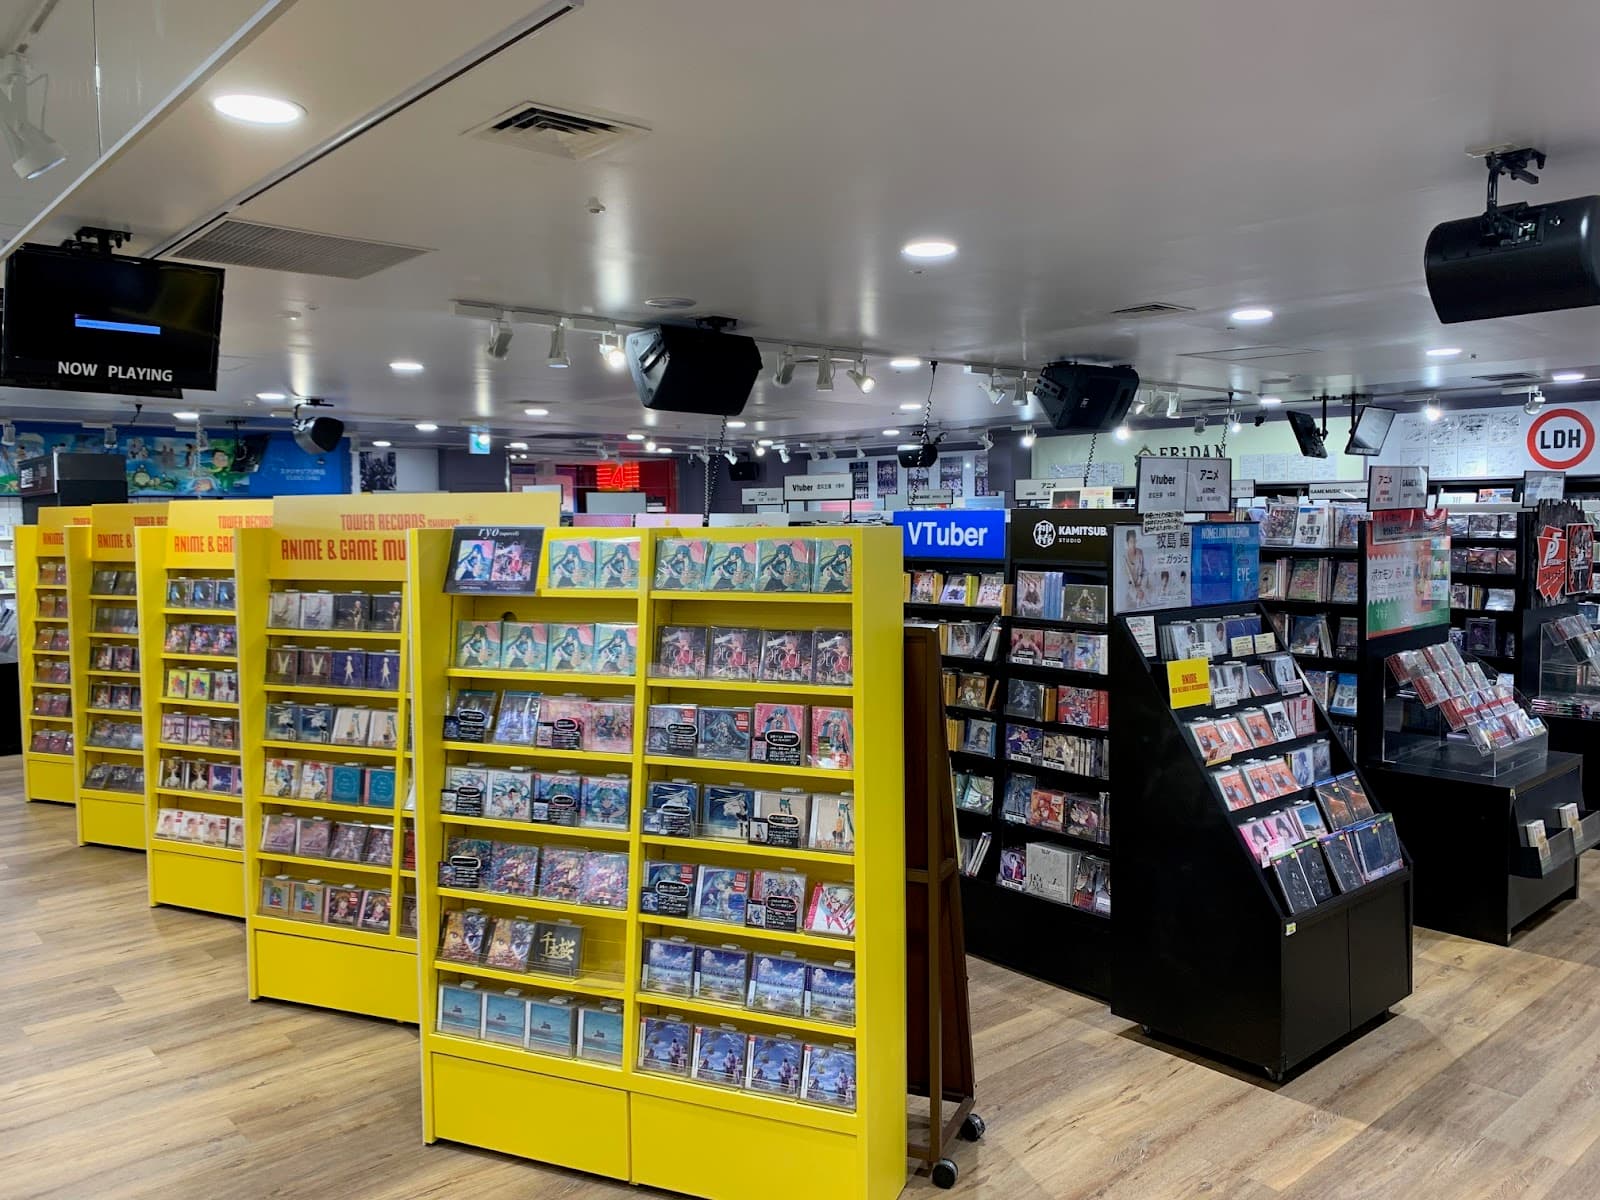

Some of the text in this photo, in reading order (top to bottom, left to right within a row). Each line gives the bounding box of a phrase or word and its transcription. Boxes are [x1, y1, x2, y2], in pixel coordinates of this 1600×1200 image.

[57, 361, 174, 382] NOW PLAYING
[1540, 428, 1582, 450] LDH
[1150, 474, 1176, 485] Vtuber
[1199, 469, 1220, 481] アニメ
[218, 516, 243, 528] TOWER
[340, 514, 375, 531] TOWER
[378, 513, 426, 530] RECORDS
[97, 534, 133, 549] ANIME &
[478, 527, 499, 540] ryo
[907, 521, 988, 547] VTuber
[174, 536, 204, 553] ANIME
[208, 536, 215, 553] &
[281, 539, 322, 561] ANIME
[327, 539, 338, 560] &
[340, 539, 378, 561] GAME
